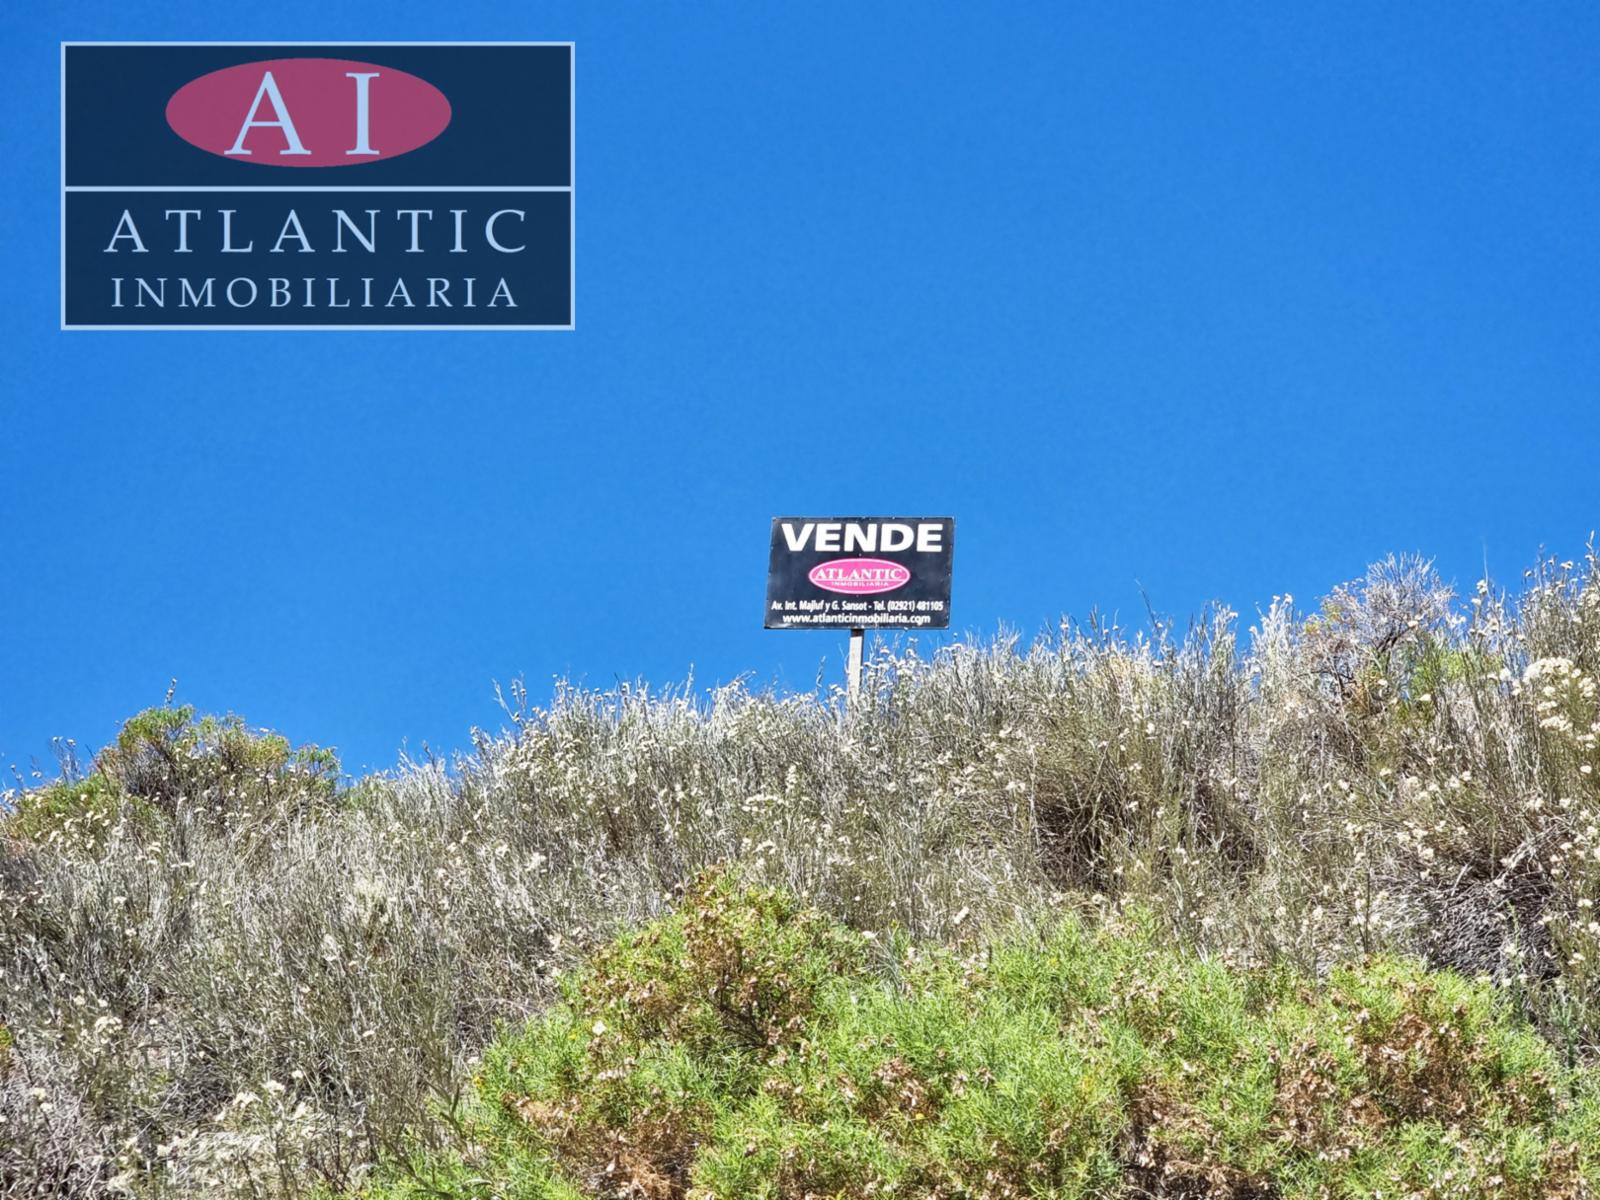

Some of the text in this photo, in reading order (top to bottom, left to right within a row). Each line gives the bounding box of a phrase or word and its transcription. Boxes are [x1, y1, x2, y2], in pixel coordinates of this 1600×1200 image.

[781, 523, 943, 552] VENDE
[815, 568, 902, 580] ATLANTIC
[771, 601, 783, 610] Av.
[785, 601, 797, 610] Int.
[825, 603, 831, 612] y
[832, 601, 840, 610] G.
[842, 601, 867, 610] Sansot
[873, 601, 885, 610] Tel.
[782, 612, 931, 624] www.atlanticinmobiliaria.com
